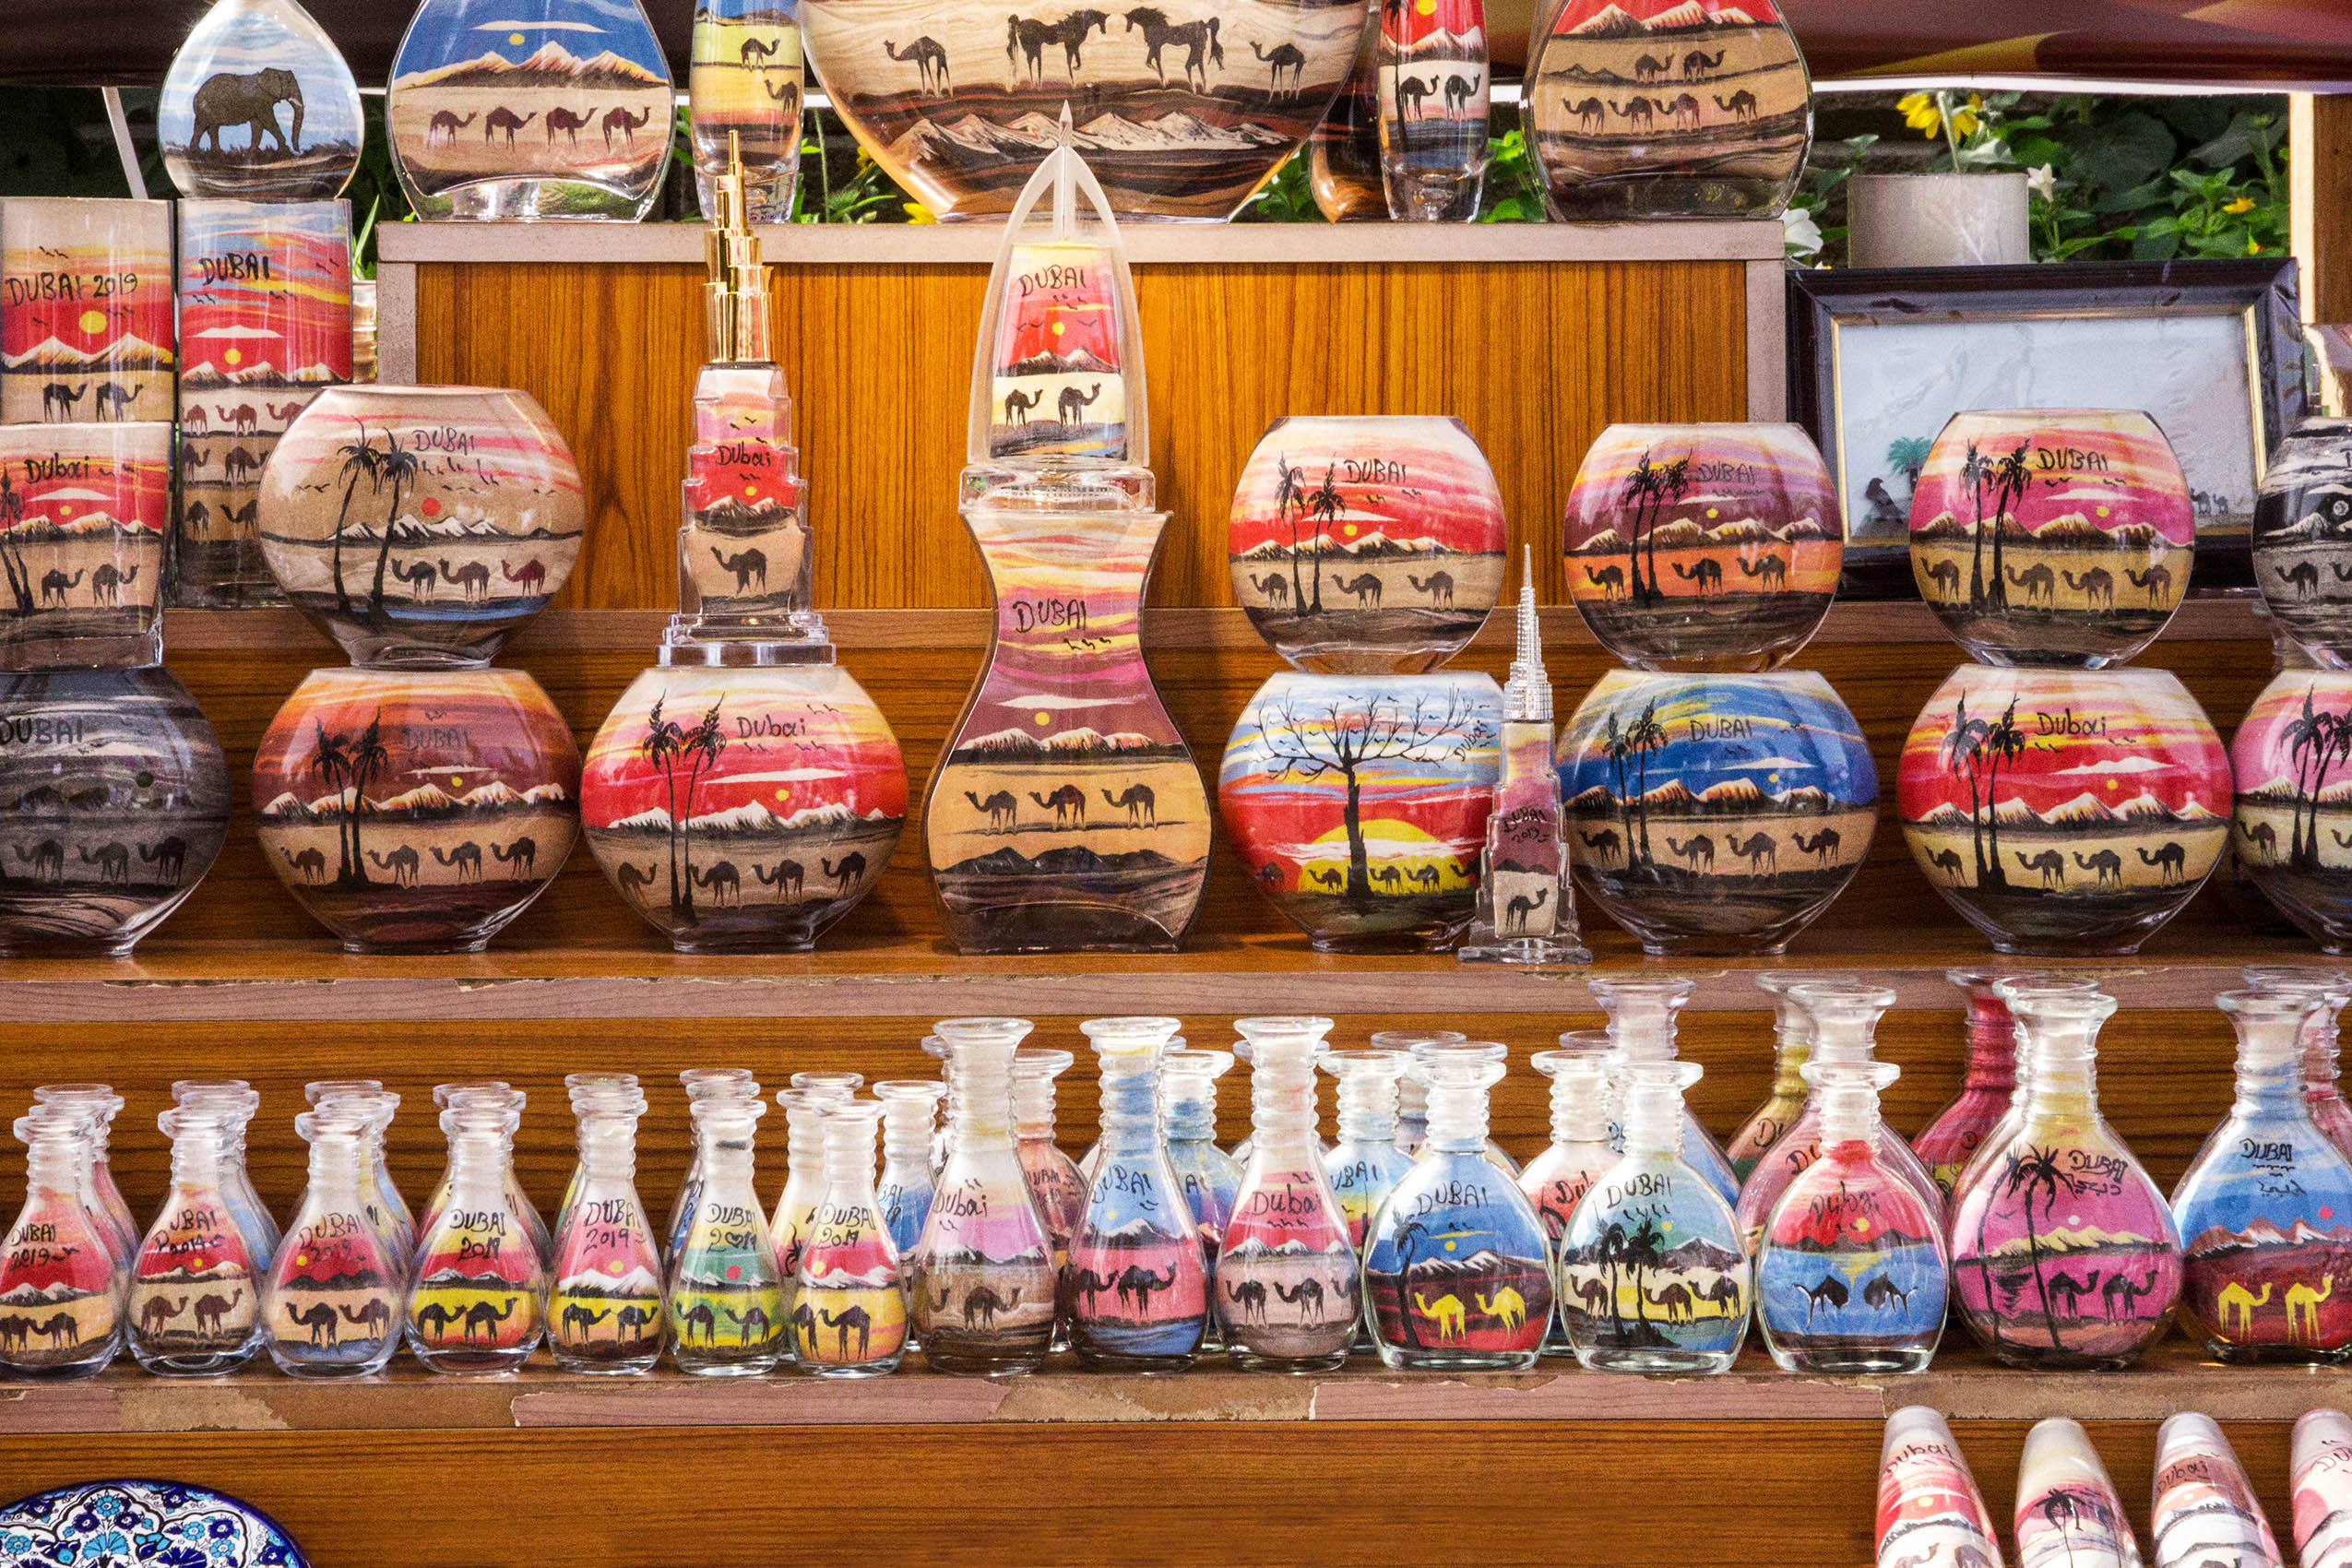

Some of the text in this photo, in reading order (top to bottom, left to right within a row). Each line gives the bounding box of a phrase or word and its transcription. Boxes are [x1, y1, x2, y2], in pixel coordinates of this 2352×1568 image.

[198, 253, 269, 286] DUBAI
[1018, 264, 1087, 298] DUBAI
[6, 271, 138, 307] DUBAI 2019
[413, 426, 475, 456] DUBAI
[1343, 457, 1408, 485] DUBAI
[2036, 445, 2109, 471] DUBAI
[1695, 462, 1757, 485] DUBAI
[1012, 600, 1088, 633] DUBAI
[737, 714, 807, 740] Dubai
[1688, 719, 1754, 742] DUBAI
[2035, 708, 2108, 738] Dubai
[402, 725, 471, 752] DUBAI
[2239, 1137, 2294, 1162] DUBAI
[2068, 1149, 2128, 1183] DUBAI
[1092, 1164, 1153, 1204] DUBAI
[1607, 1172, 1672, 1209] DUBAI
[1417, 1180, 1489, 1217] DUBAI
[450, 1208, 506, 1235] DUBAI
[584, 1198, 642, 1229] DUBAI
[706, 1202, 757, 1232] DUBAI
[817, 1203, 876, 1230] DUBAI
[9, 1222, 57, 1247] DUBAI
[299, 1211, 365, 1250] DUBAI
[583, 1228, 630, 1254] 2019
[817, 1228, 859, 1250] 2019
[9, 1247, 50, 1272] 2019
[457, 1236, 502, 1263] 2019
